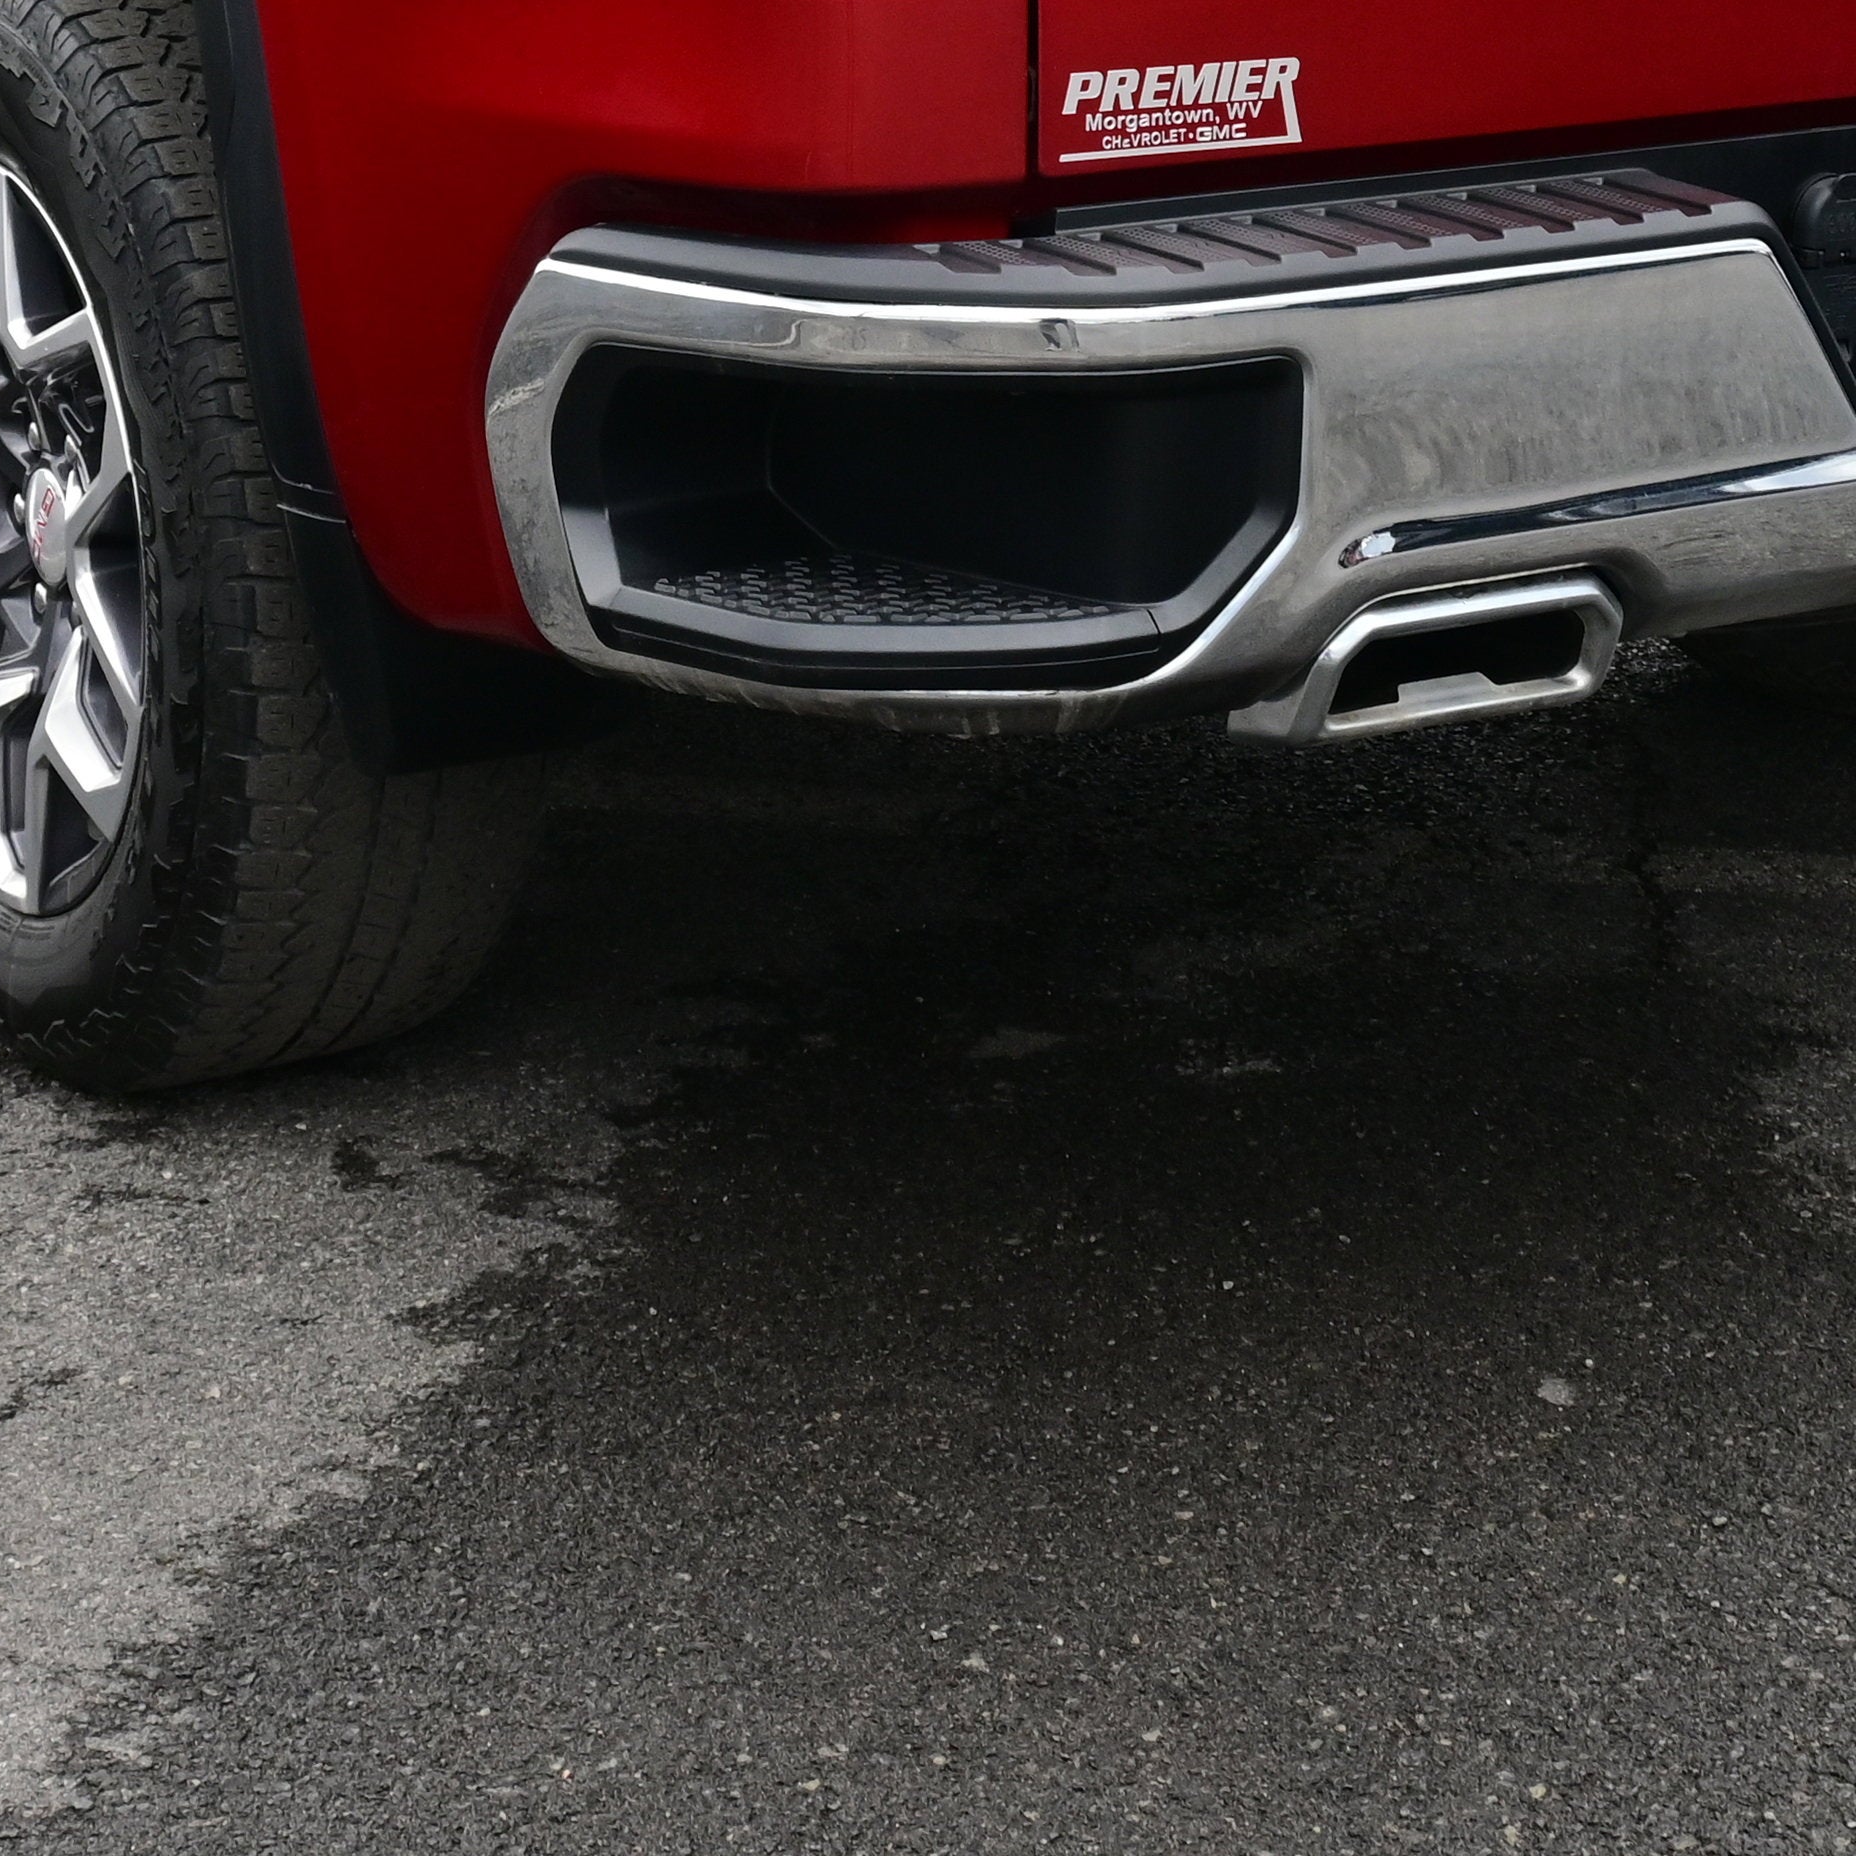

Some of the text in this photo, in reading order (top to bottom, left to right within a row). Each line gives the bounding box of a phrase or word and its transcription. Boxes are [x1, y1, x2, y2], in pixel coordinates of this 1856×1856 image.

[1061, 56, 1301, 116] PREMIER
[1085, 100, 1263, 132] Morgantown, WV
[1196, 123, 1247, 142] GMC
